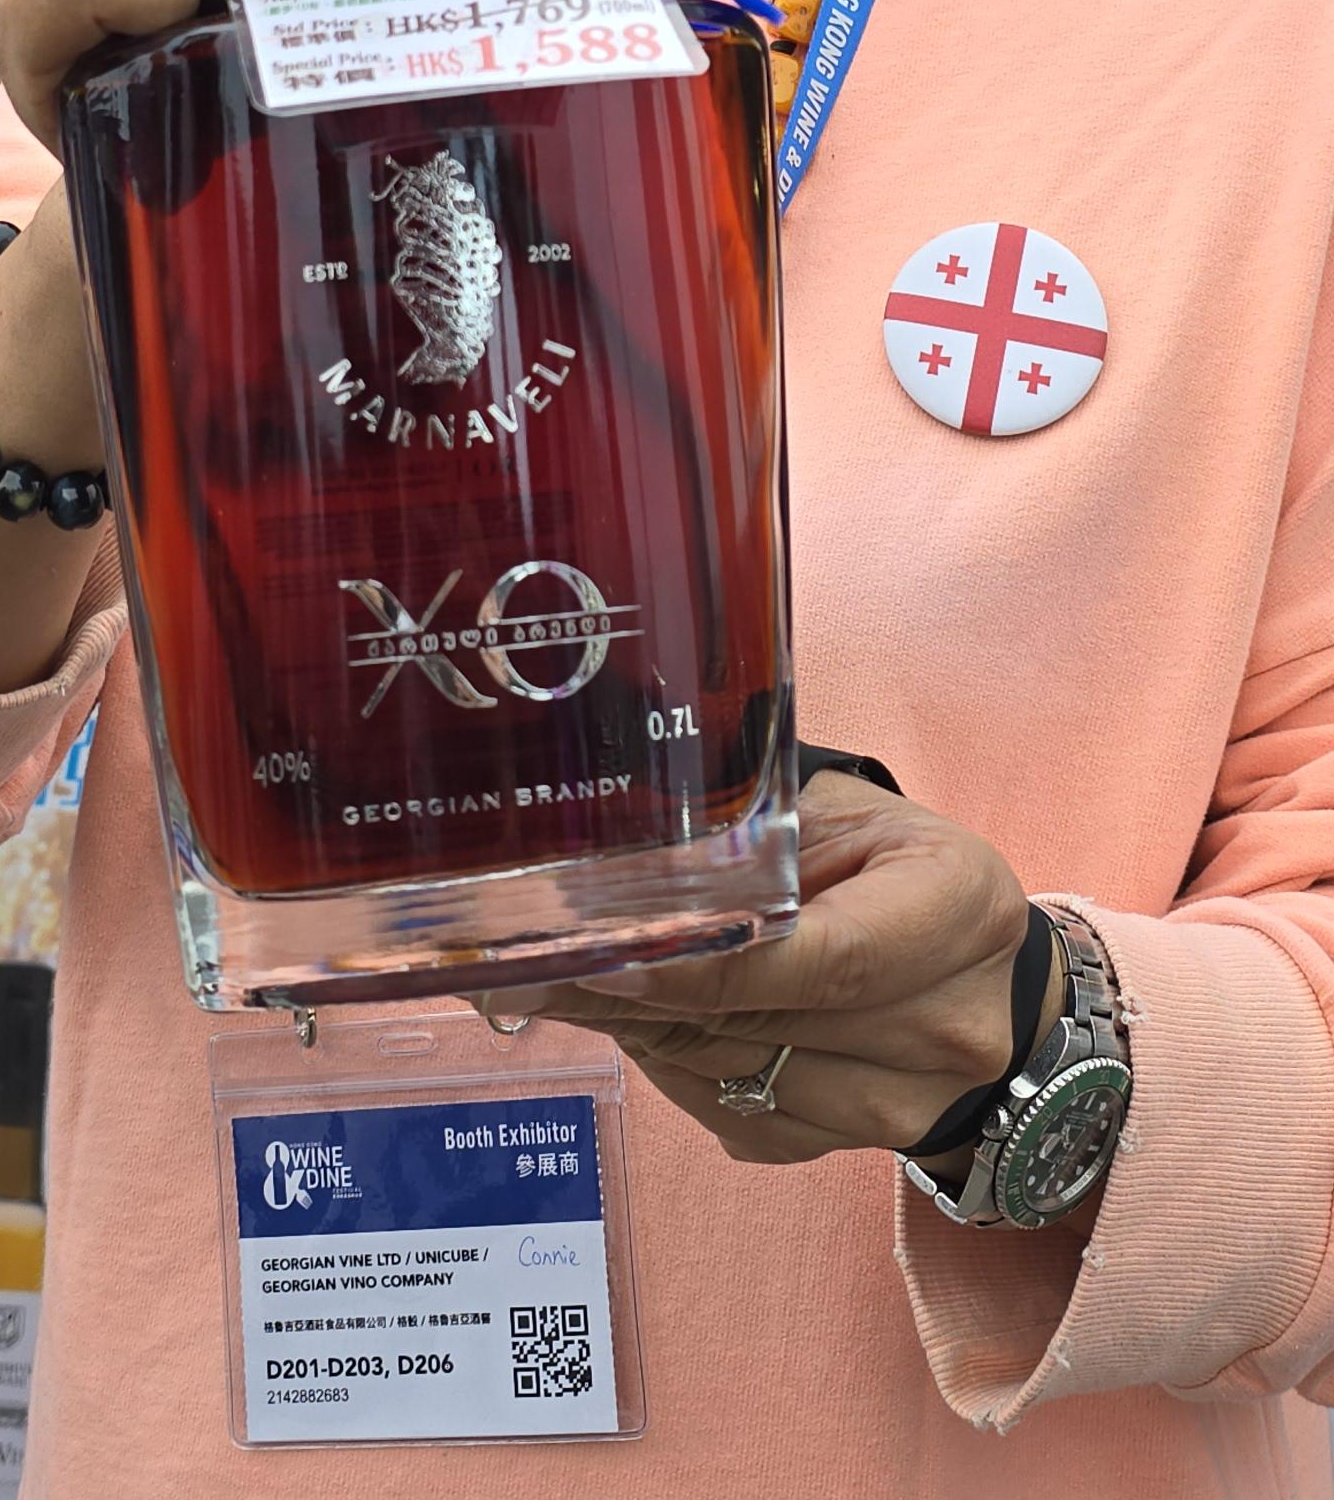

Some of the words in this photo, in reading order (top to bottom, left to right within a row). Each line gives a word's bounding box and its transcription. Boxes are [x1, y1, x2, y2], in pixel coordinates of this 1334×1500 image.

[312, 17, 360, 31] Price
[814, 10, 856, 81] KONG
[272, 54, 333, 75] Special
[338, 51, 382, 66] Price
[792, 77, 832, 149] WINE
[786, 145, 803, 169] &
[528, 243, 572, 263] 2002
[319, 338, 577, 450] MARNAVELI
[338, 560, 610, 719] XO
[647, 705, 700, 741] 0.7L
[252, 750, 312, 789] 40%
[341, 790, 502, 826] GEORGIAN
[514, 773, 633, 809] BRANDY
[444, 1124, 494, 1151] Booth
[498, 1121, 578, 1148] Exhibitor
[291, 1145, 344, 1169] WINE
[515, 1150, 580, 1178] 參展商
[306, 1166, 353, 1190] DINE
[261, 1254, 335, 1273] GEORGIAN
[338, 1253, 374, 1269] VINE
[376, 1252, 402, 1268] LTD
[415, 1248, 479, 1265] UNICUBE
[517, 1235, 581, 1268] Connie
[262, 1276, 337, 1295] GEORGIAN
[339, 1274, 377, 1291] VINO
[380, 1272, 455, 1290] COMPANY
[266, 1356, 390, 1380] D201-D203,
[397, 1353, 454, 1376] D206
[266, 1388, 349, 1405] 2142882683
